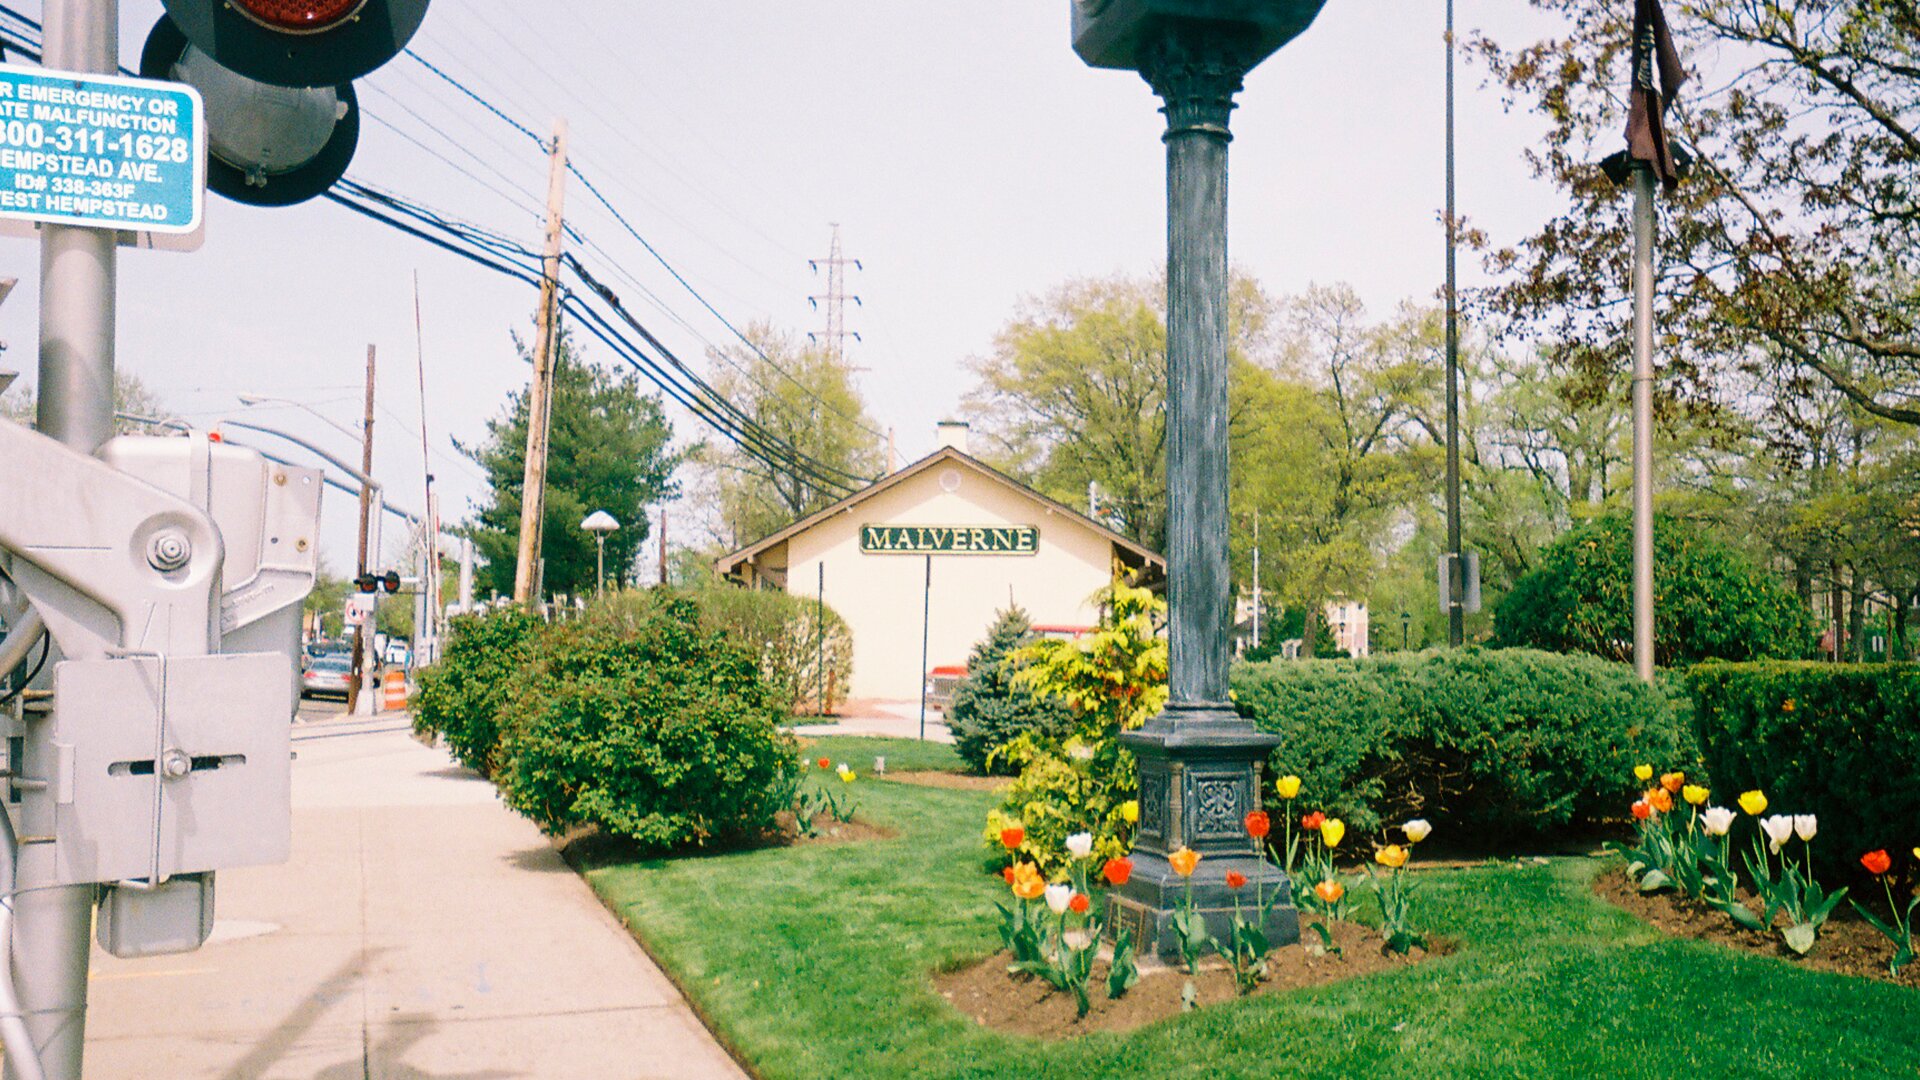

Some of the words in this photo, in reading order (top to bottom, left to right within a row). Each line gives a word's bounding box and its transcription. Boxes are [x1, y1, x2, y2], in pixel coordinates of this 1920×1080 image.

[0, 81, 14, 98] R
[18, 83, 145, 112] EMERGENCY
[148, 98, 178, 117] OR
[33, 104, 176, 134] MALFUNCTION
[1, 148, 113, 178] EMPSTEAD
[118, 161, 163, 183] AVE.
[15, 172, 47, 191] ID#
[51, 177, 136, 199] 338-363F
[45, 194, 168, 220] HEMPSTEAD
[867, 527, 1032, 550] MALVERNE
